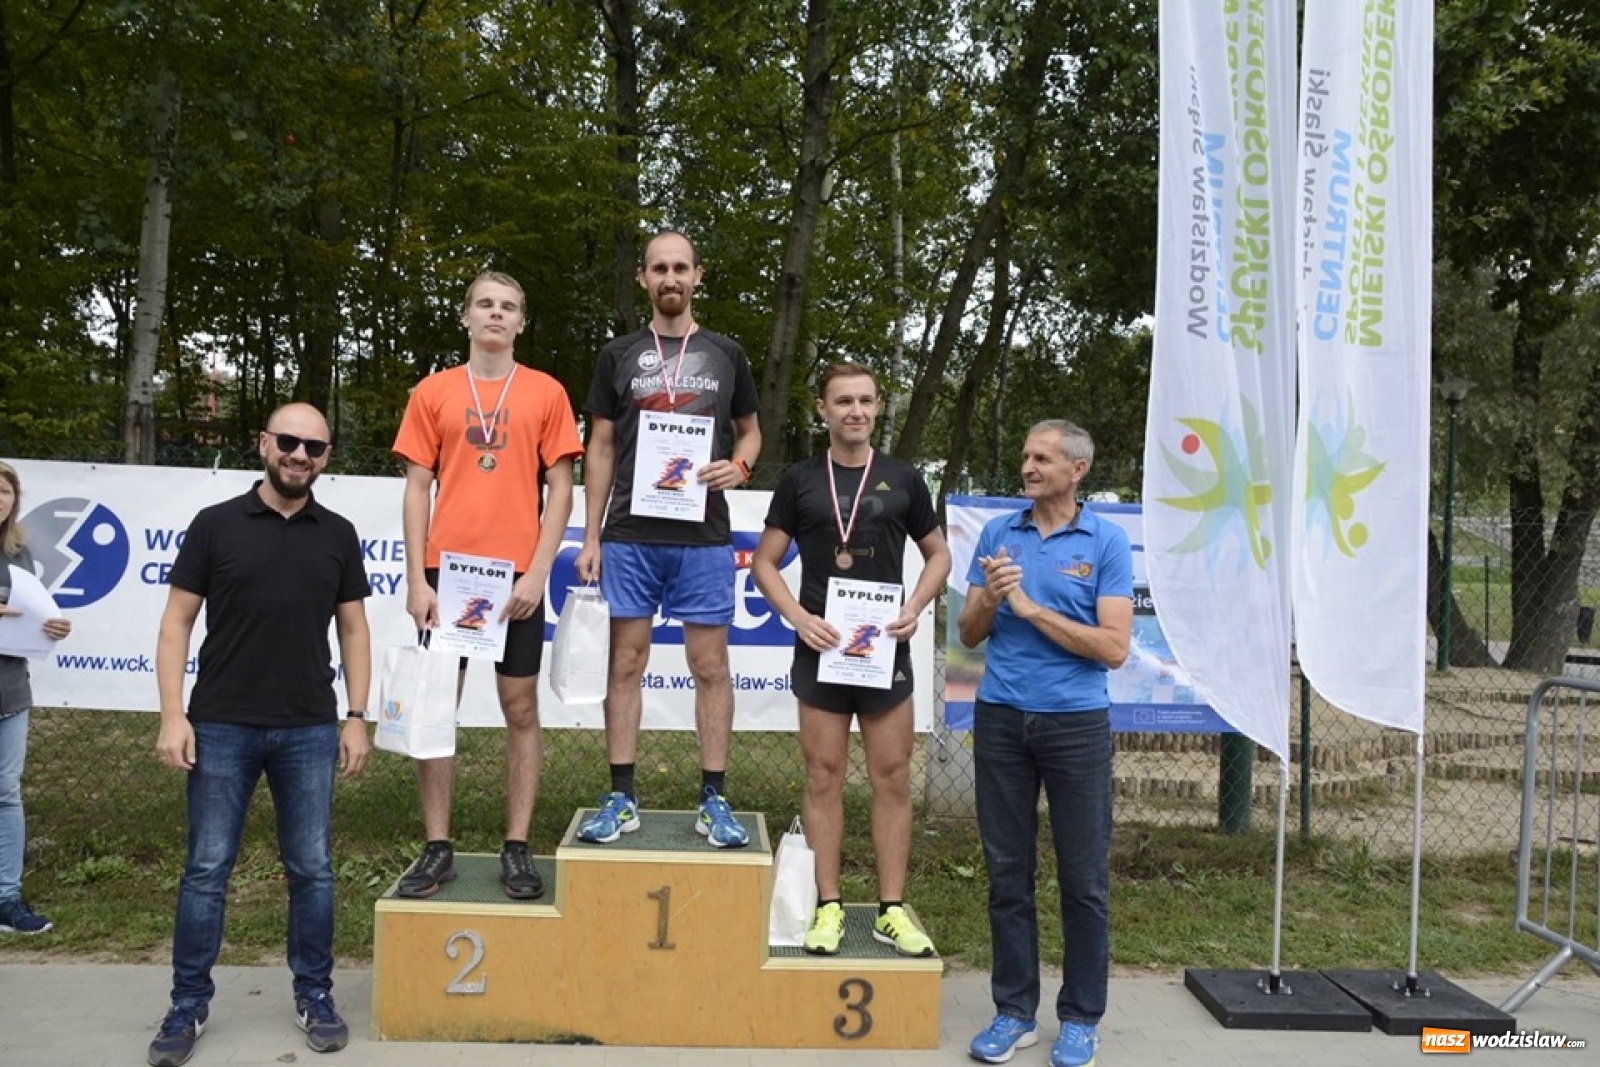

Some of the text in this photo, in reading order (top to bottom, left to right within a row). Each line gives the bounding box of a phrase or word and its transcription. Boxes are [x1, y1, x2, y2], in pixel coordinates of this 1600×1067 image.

[648, 422, 706, 436] DYPLOM
[449, 562, 506, 578] DYPLOM
[837, 589, 894, 603] DYPLOM
[647, 886, 676, 949] 1
[444, 930, 487, 995] 2
[833, 977, 874, 1039] 3
